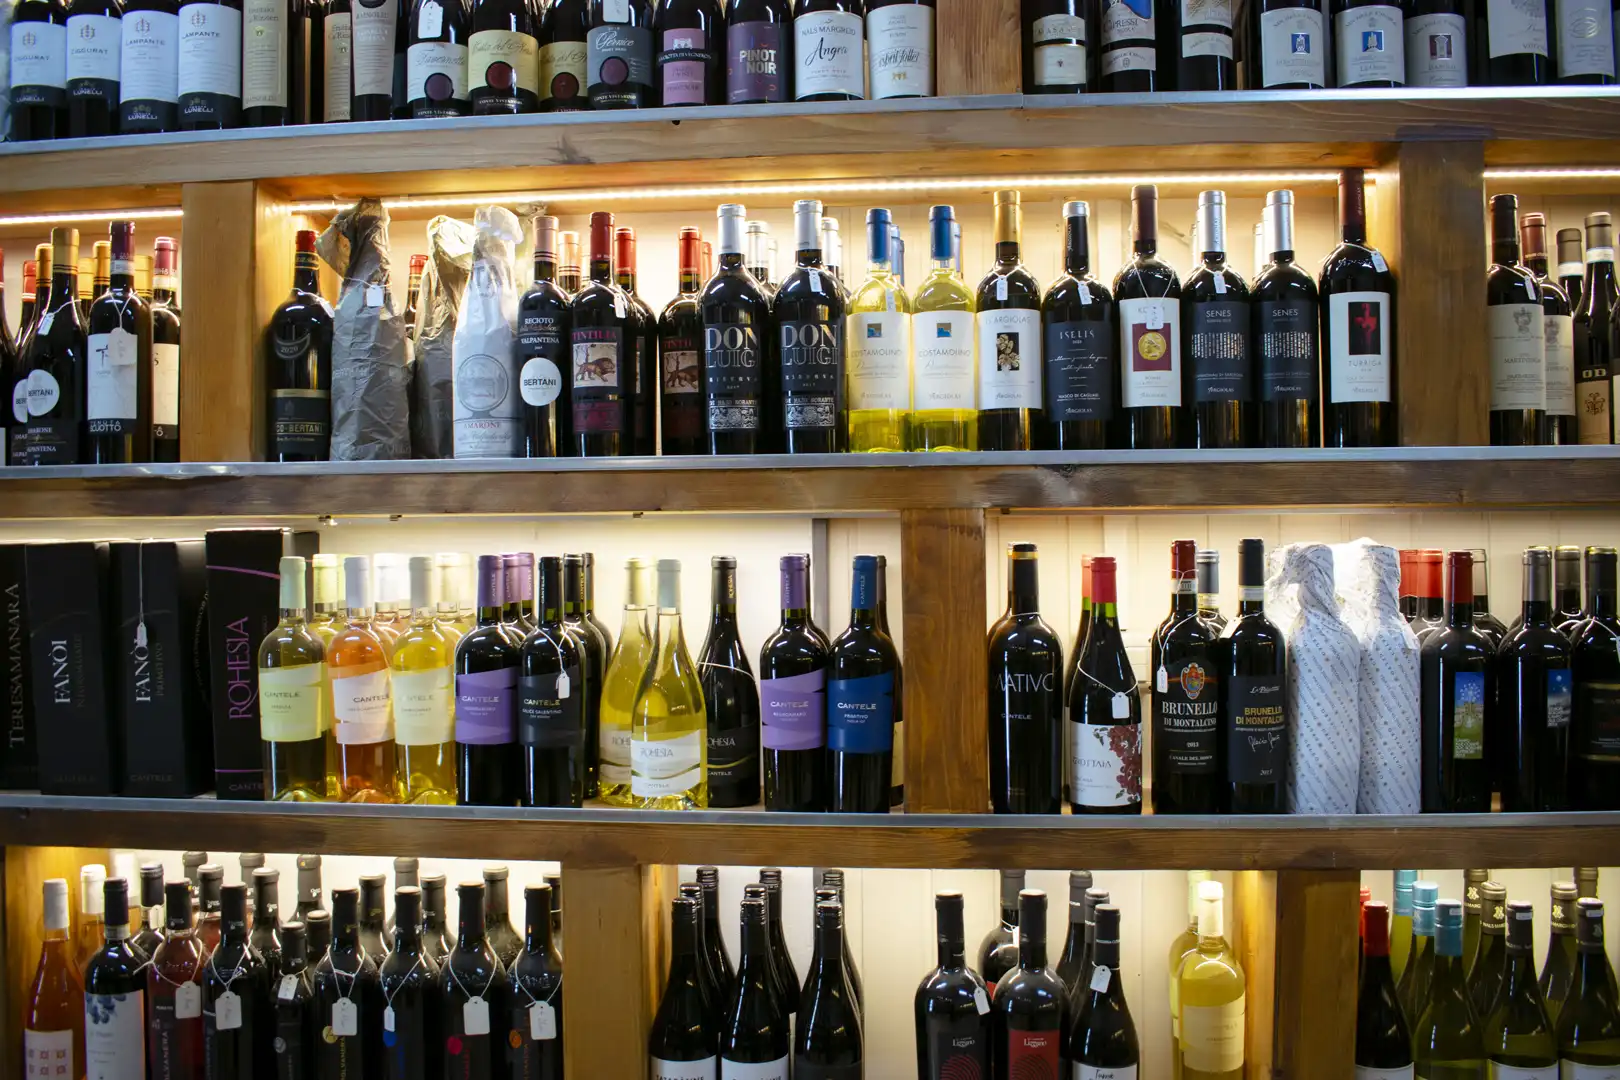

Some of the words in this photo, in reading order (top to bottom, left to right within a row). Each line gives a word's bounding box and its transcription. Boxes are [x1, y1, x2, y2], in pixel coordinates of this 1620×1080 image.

[740, 50, 777, 62] PINOT
[746, 62, 777, 75] NOIR
[1206, 310, 1232, 318] SENES
[1272, 308, 1299, 317] SENES
[994, 315, 1031, 324] ARGIOLAS
[704, 326, 758, 350] DON
[781, 324, 838, 348] DON
[1060, 330, 1095, 340] ISELIS
[781, 346, 840, 366] LUIGI
[850, 348, 903, 358] COSTAMOLINO
[918, 348, 971, 358] COSTAMOLINO
[524, 378, 556, 386] BERTANI
[4, 583, 25, 748] TERESAMANARA
[226, 616, 253, 720] ROHESIA
[48, 640, 71, 704] FANÒI
[130, 642, 151, 702] FANÒ
[264, 690, 300, 698] CANTELE
[461, 695, 500, 703] CANTELE
[837, 702, 876, 710] CANTELE
[1162, 700, 1218, 716] BRUNELLO
[1244, 706, 1282, 716] BRUNELLO
[1164, 718, 1172, 726] DI
[1173, 718, 1217, 728] MONTALCINO
[1236, 716, 1244, 724] DI
[612, 736, 632, 746] ROHE
[640, 748, 674, 758] ROHESIA
[229, 782, 264, 792] CANTE
